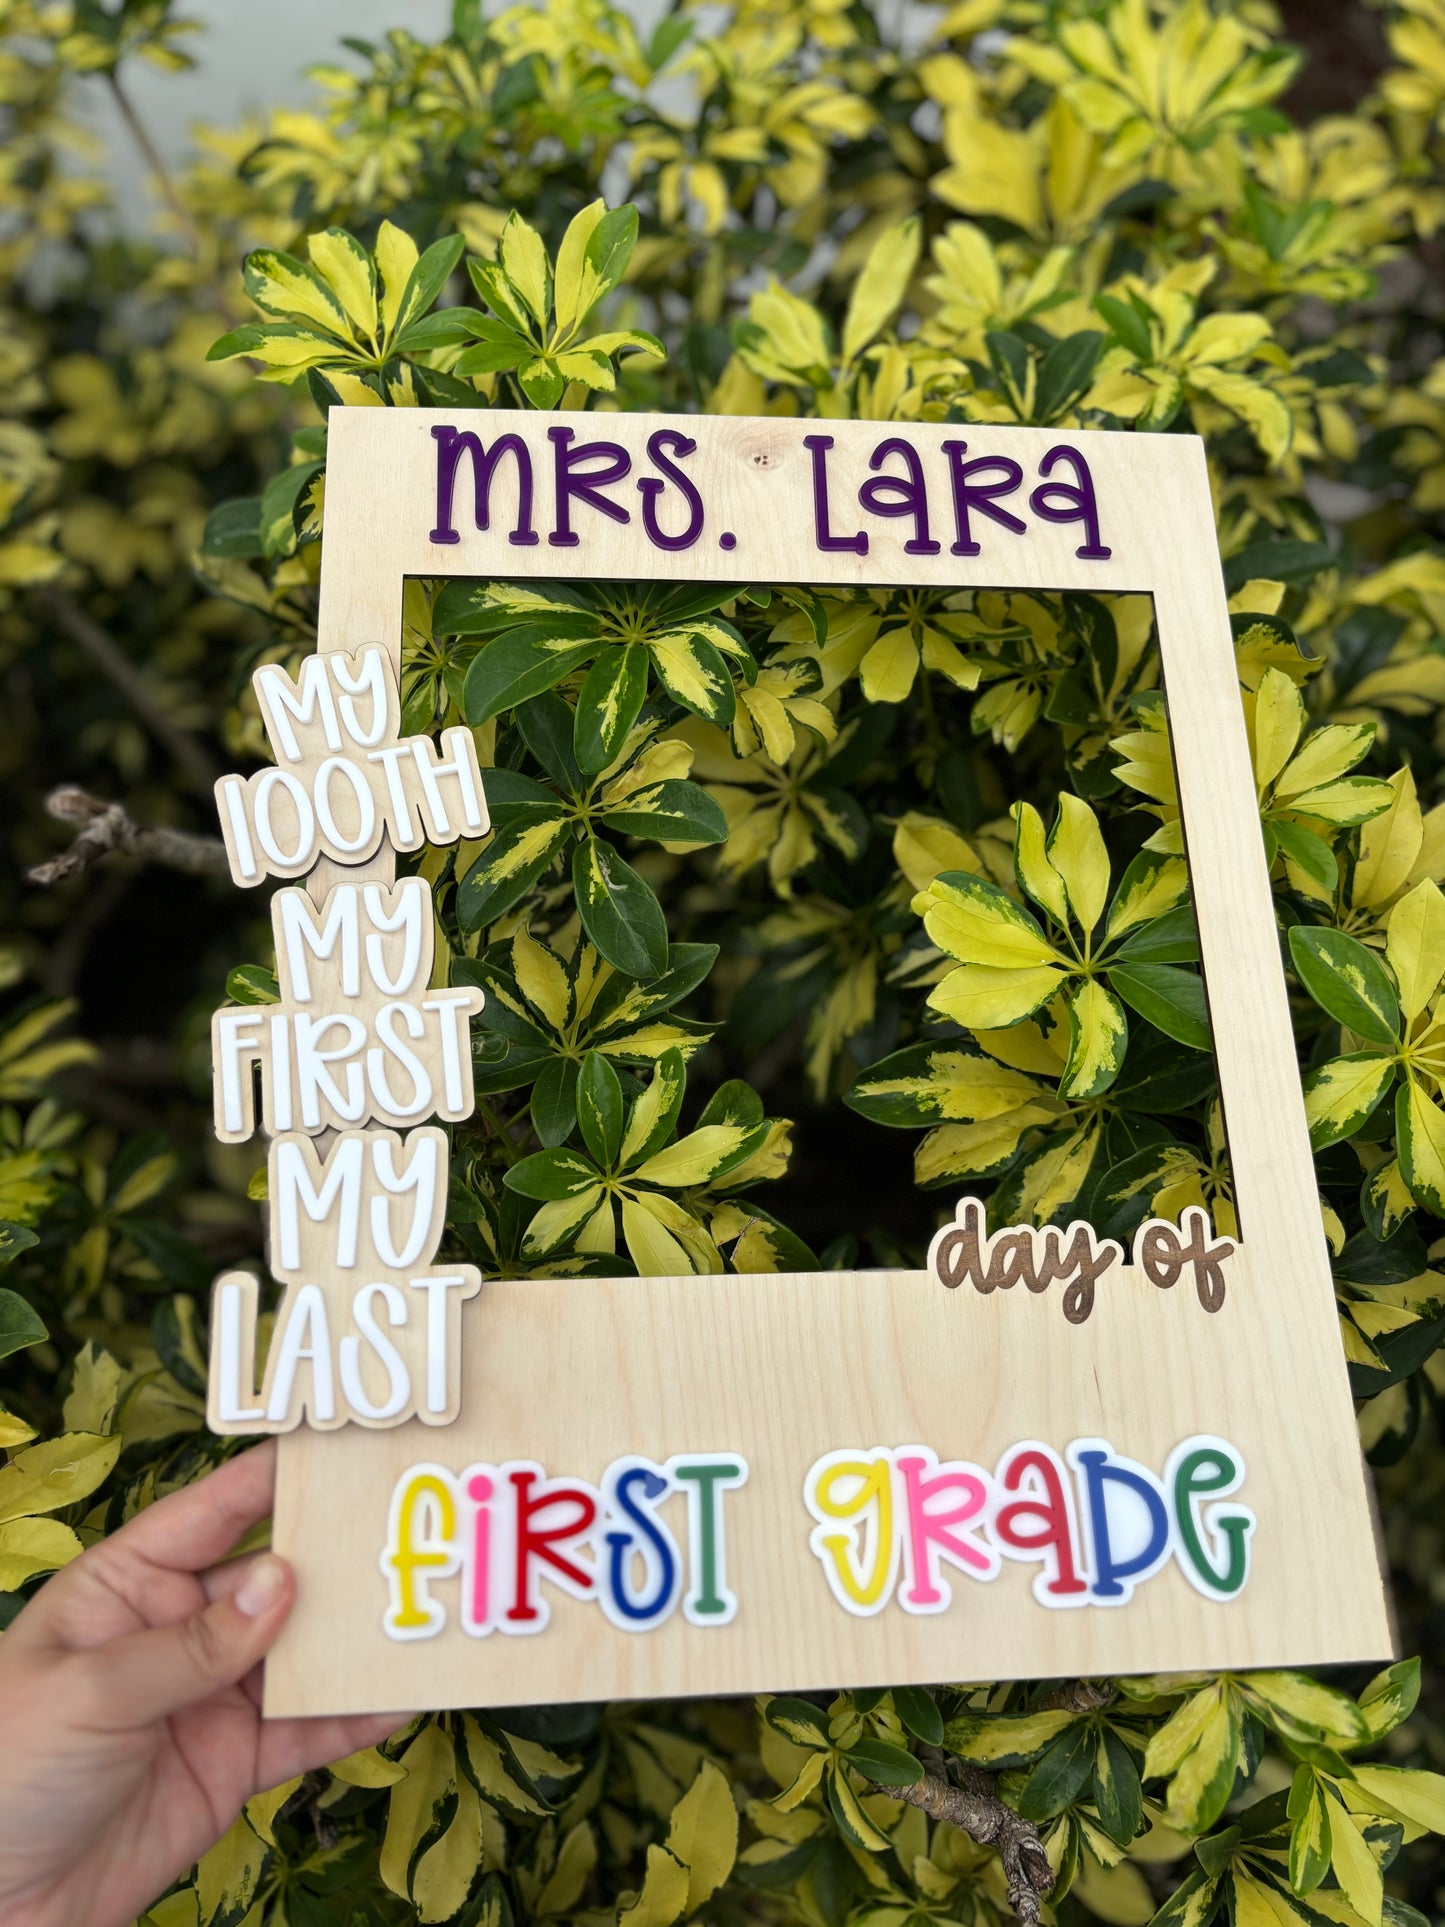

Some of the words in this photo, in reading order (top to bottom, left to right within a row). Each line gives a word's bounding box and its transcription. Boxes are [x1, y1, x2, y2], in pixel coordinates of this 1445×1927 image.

[219, 997, 472, 1132] FIRST
[936, 1203, 1117, 1324] day
[1142, 1212, 1235, 1313] of
[219, 1276, 466, 1422] LAST
